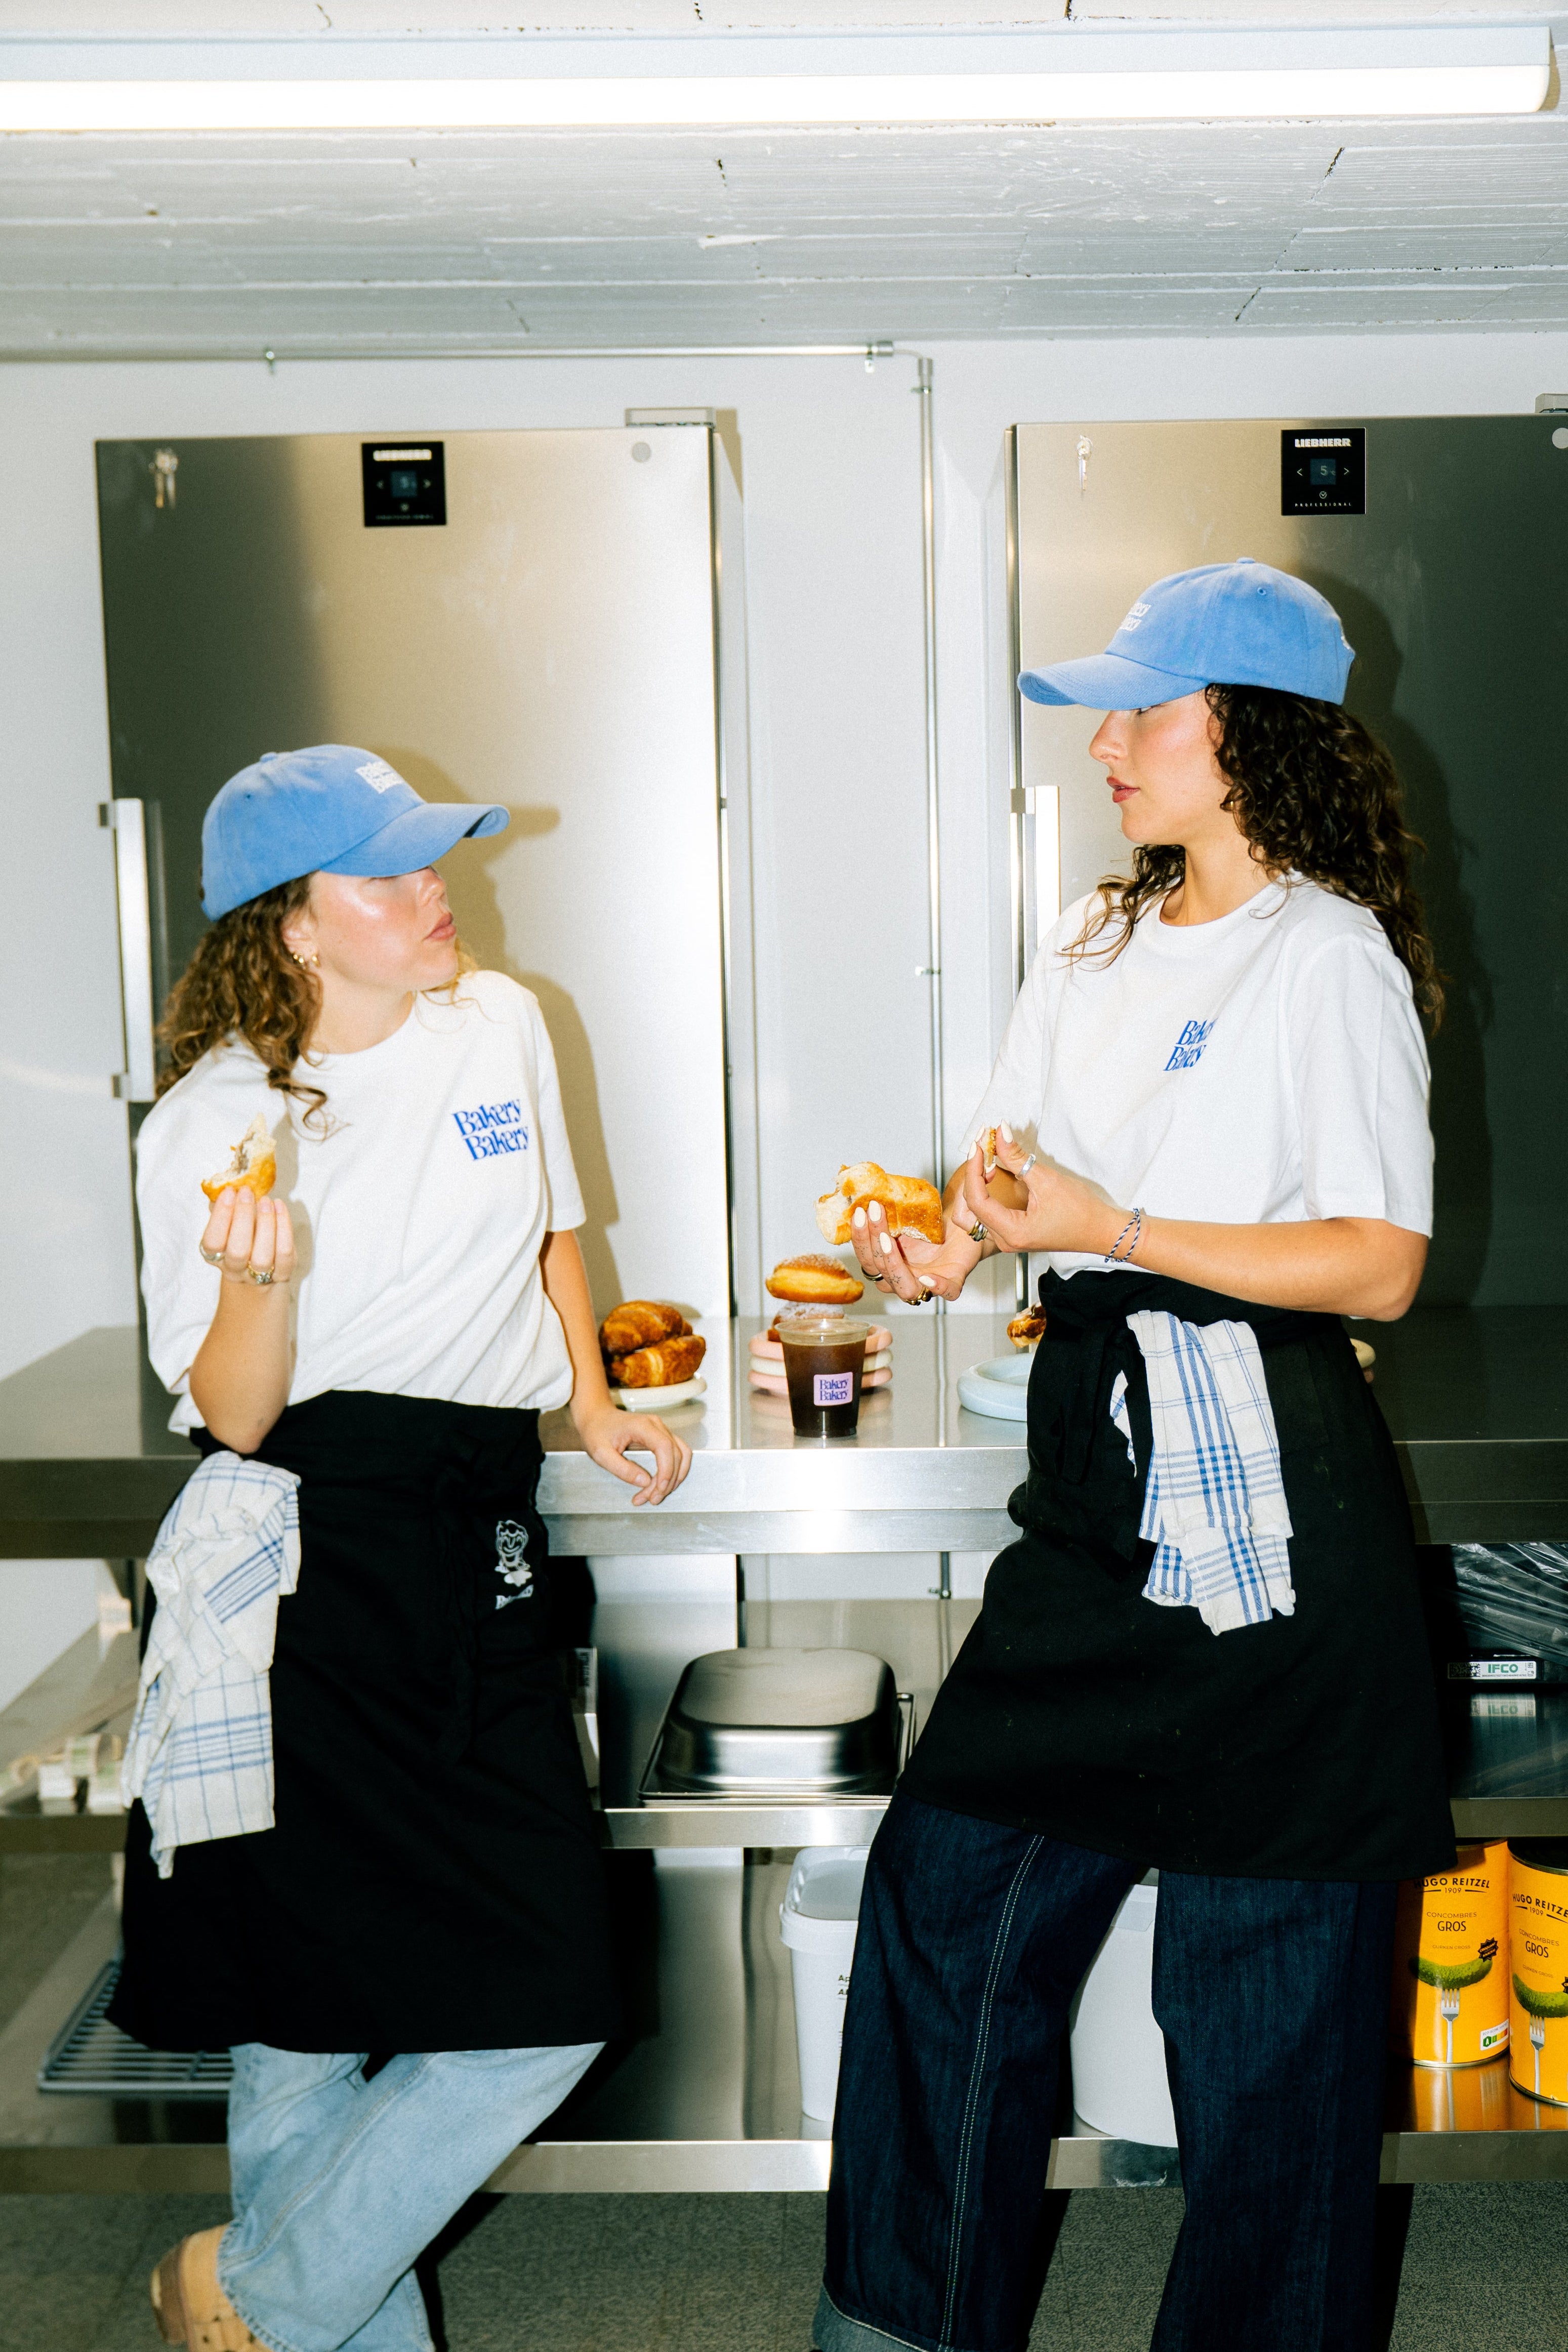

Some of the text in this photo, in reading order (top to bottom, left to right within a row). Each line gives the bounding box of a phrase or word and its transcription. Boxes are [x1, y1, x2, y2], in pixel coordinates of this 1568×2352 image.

[1295, 438, 1351, 447] LIEBHERR
[1321, 465, 1328, 476] 5
[452, 1099, 520, 1136] Bakery
[464, 1127, 528, 1161] Bakery
[820, 1379, 848, 1390] Bakery
[820, 1390, 848, 1401] Bakery
[1488, 1664, 1518, 1673] IFCO
[1414, 1878, 1490, 1888] HUGO REITZEL
[1512, 1893, 1532, 1904] HUGO
[1530, 1906, 1544, 1916] 1909
[1437, 1921, 1467, 1931] GROS
[1519, 1928, 1559, 1947] CONCOMBRES
[1525, 1941, 1549, 1958] GROS
